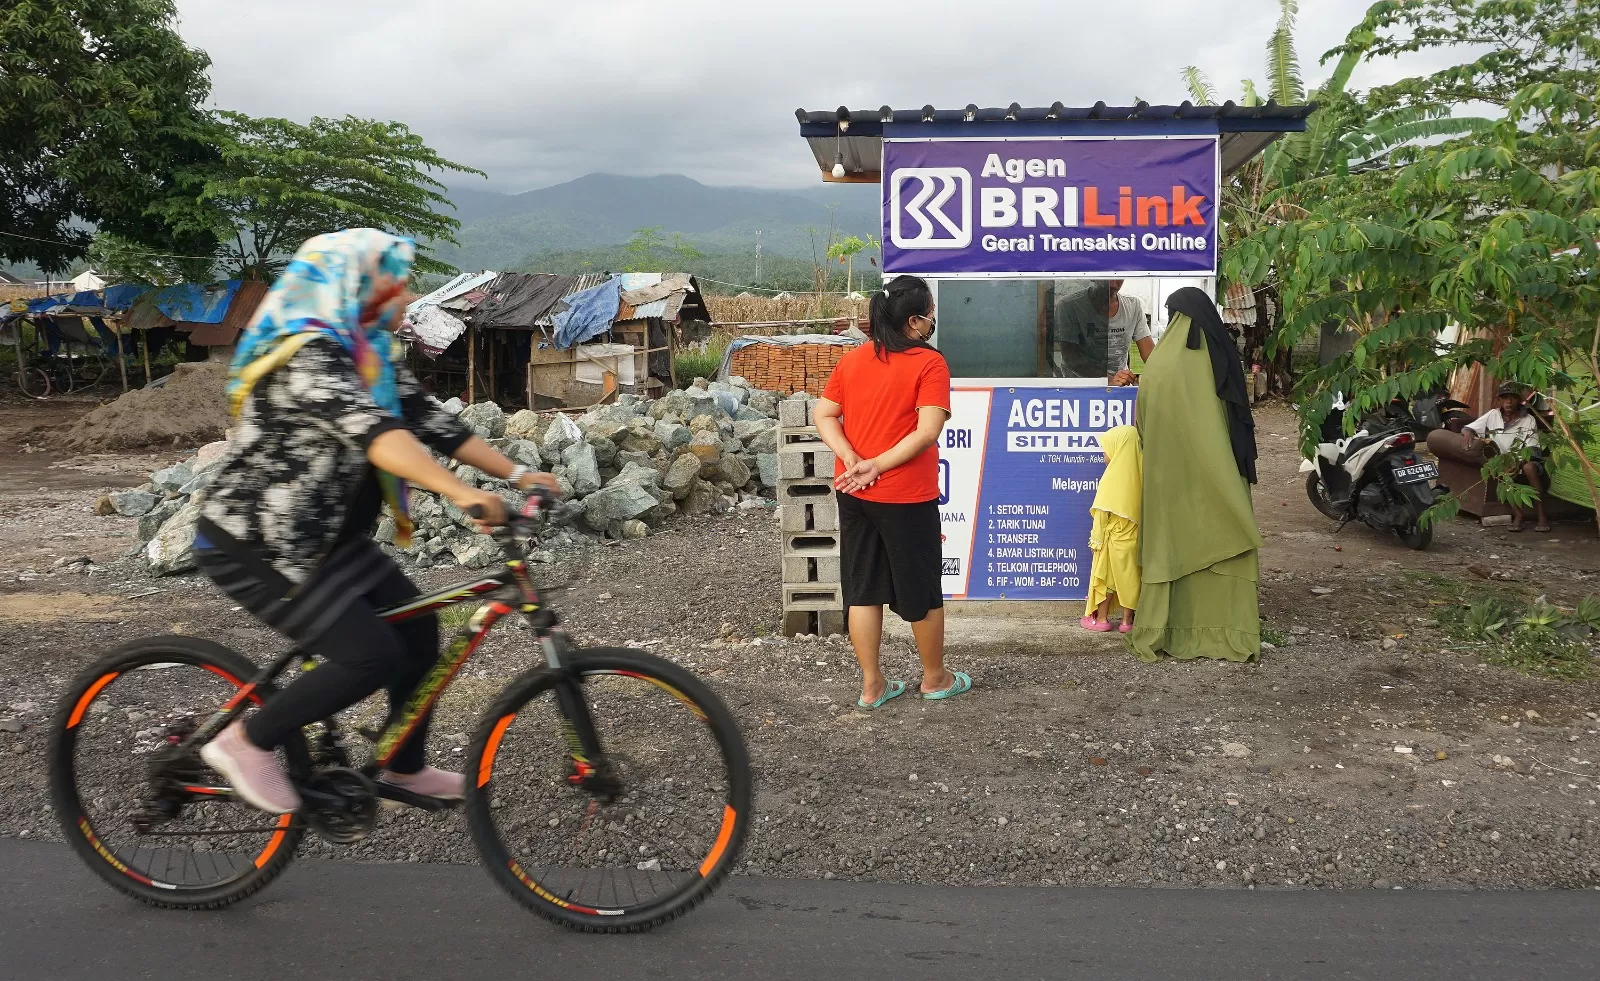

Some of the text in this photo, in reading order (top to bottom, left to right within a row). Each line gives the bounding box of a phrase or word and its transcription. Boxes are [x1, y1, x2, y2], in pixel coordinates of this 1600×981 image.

[980, 153, 1067, 183] Agen
[980, 186, 1207, 228] BRILink
[981, 232, 1207, 252] Gerai Transaksi Online
[1007, 398, 1133, 428] AGEN BRI
[946, 428, 972, 449] BRI
[1015, 435, 1102, 448] SITI HA
[988, 505, 1049, 515] 1. SETOR TUNAI
[940, 512, 966, 522] IANA
[988, 519, 1046, 529] 2. TARIK TUNAI
[988, 534, 1039, 544] 3. TRANSFER
[987, 548, 1077, 560] 4. BAYAR LISTRIK (PLN)
[987, 562, 1078, 575] 5. TELKOM (TELEPHON)
[987, 577, 995, 587] 6.
[996, 577, 1009, 587] FIF
[1014, 577, 1034, 587] WOM
[1040, 577, 1057, 587] BAF
[1063, 577, 1080, 587] OTO
